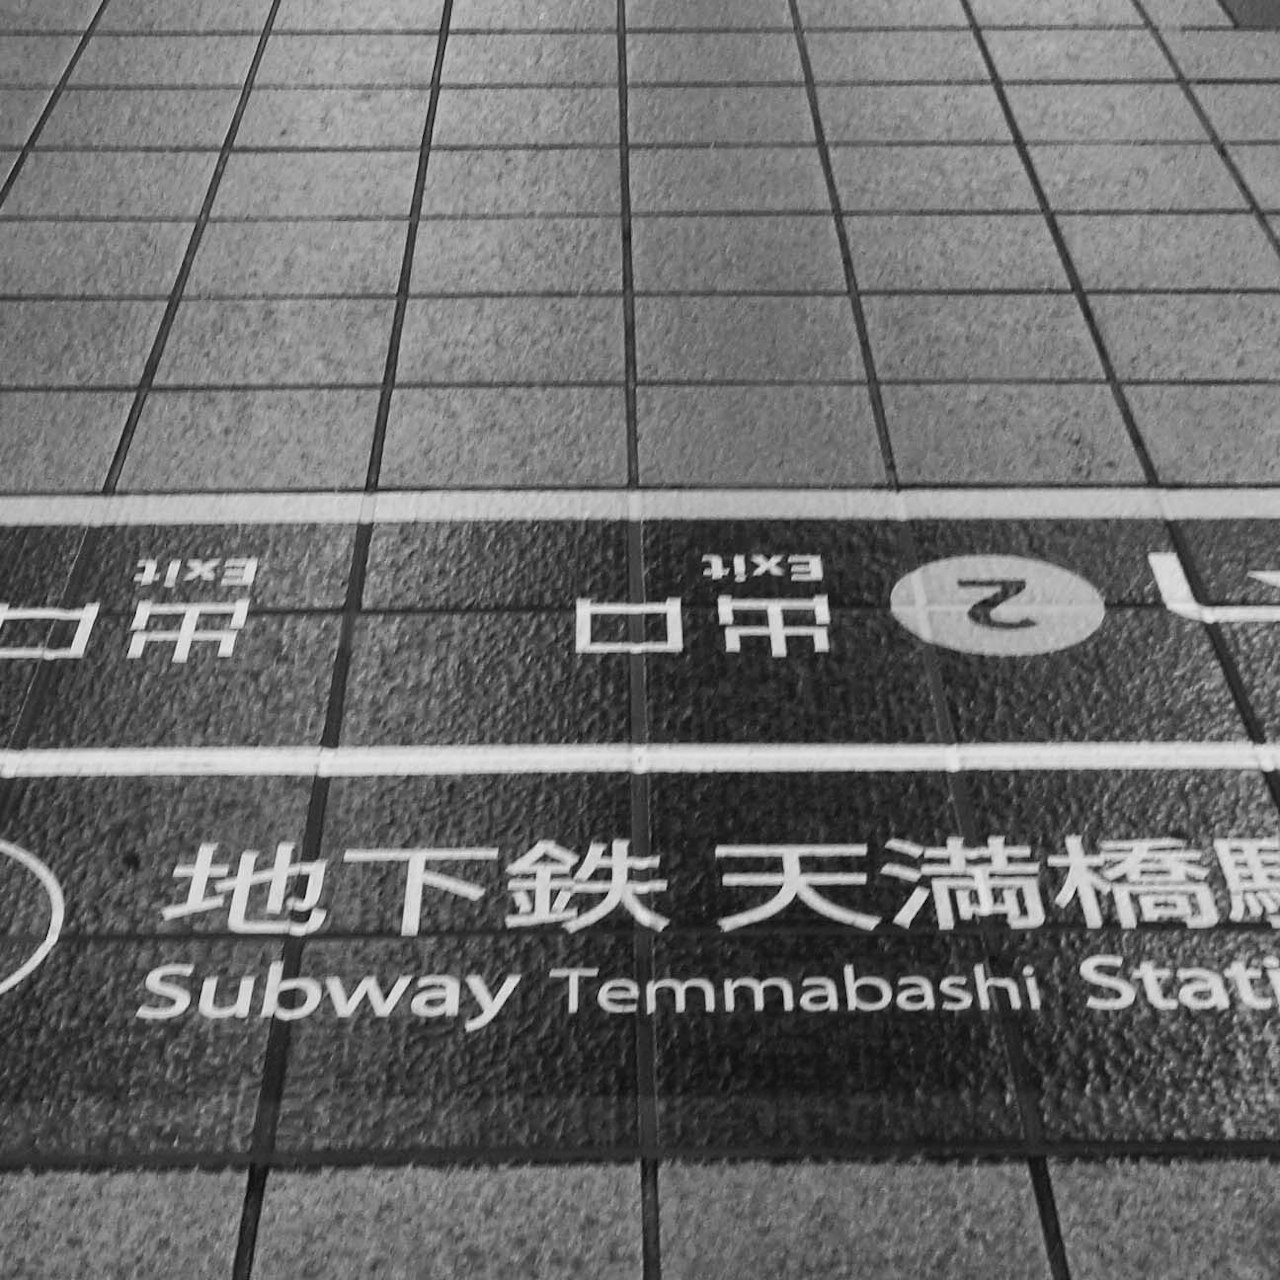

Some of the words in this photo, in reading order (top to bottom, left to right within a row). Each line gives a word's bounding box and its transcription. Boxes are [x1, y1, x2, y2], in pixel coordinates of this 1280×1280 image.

[134, 556, 257, 588] Exit
[701, 553, 823, 583] Exit
[576, 594, 830, 658] 出口
[957, 577, 1038, 629] 2
[134, 961, 522, 1032] Subway
[550, 962, 1041, 1014] Temmabashi
